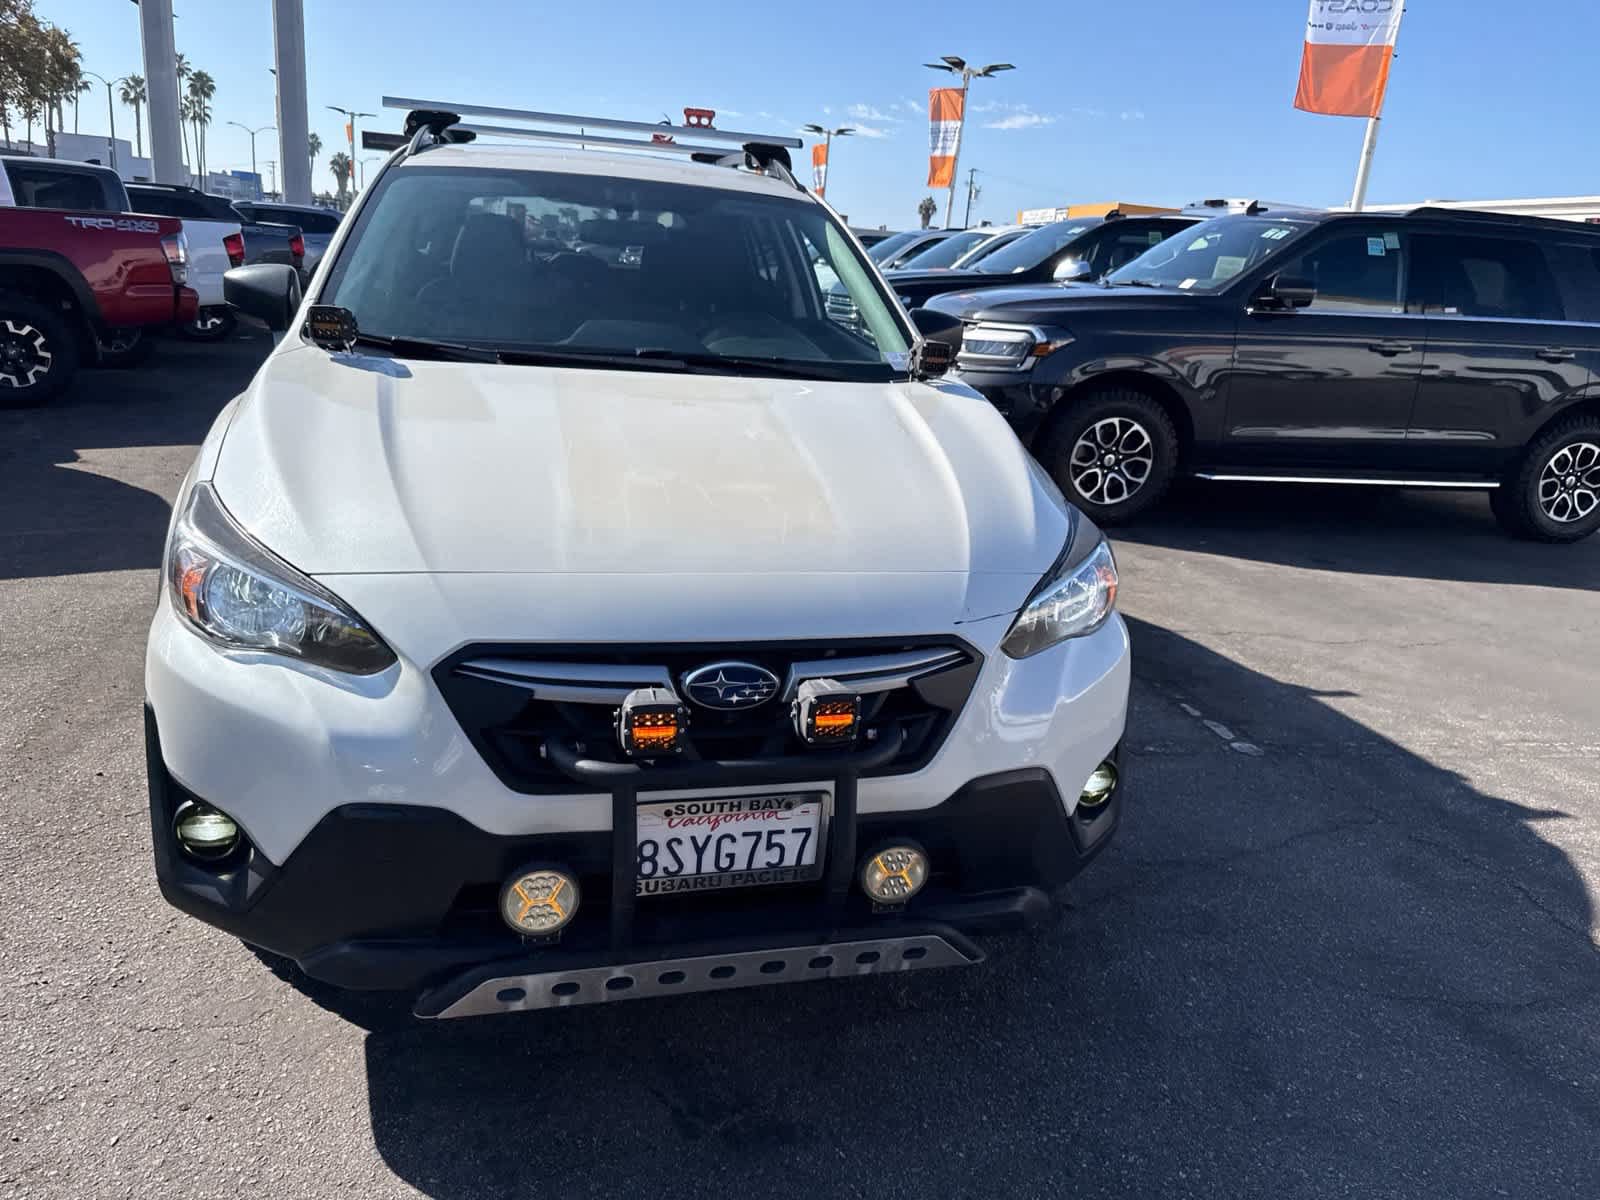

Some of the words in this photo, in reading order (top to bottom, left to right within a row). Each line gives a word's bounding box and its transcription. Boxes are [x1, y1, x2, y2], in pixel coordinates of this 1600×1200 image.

[64, 215, 115, 230] TRD
[673, 801, 742, 816] SOUTH
[749, 798, 785, 811] BAY
[638, 827, 812, 880] 8SYG757
